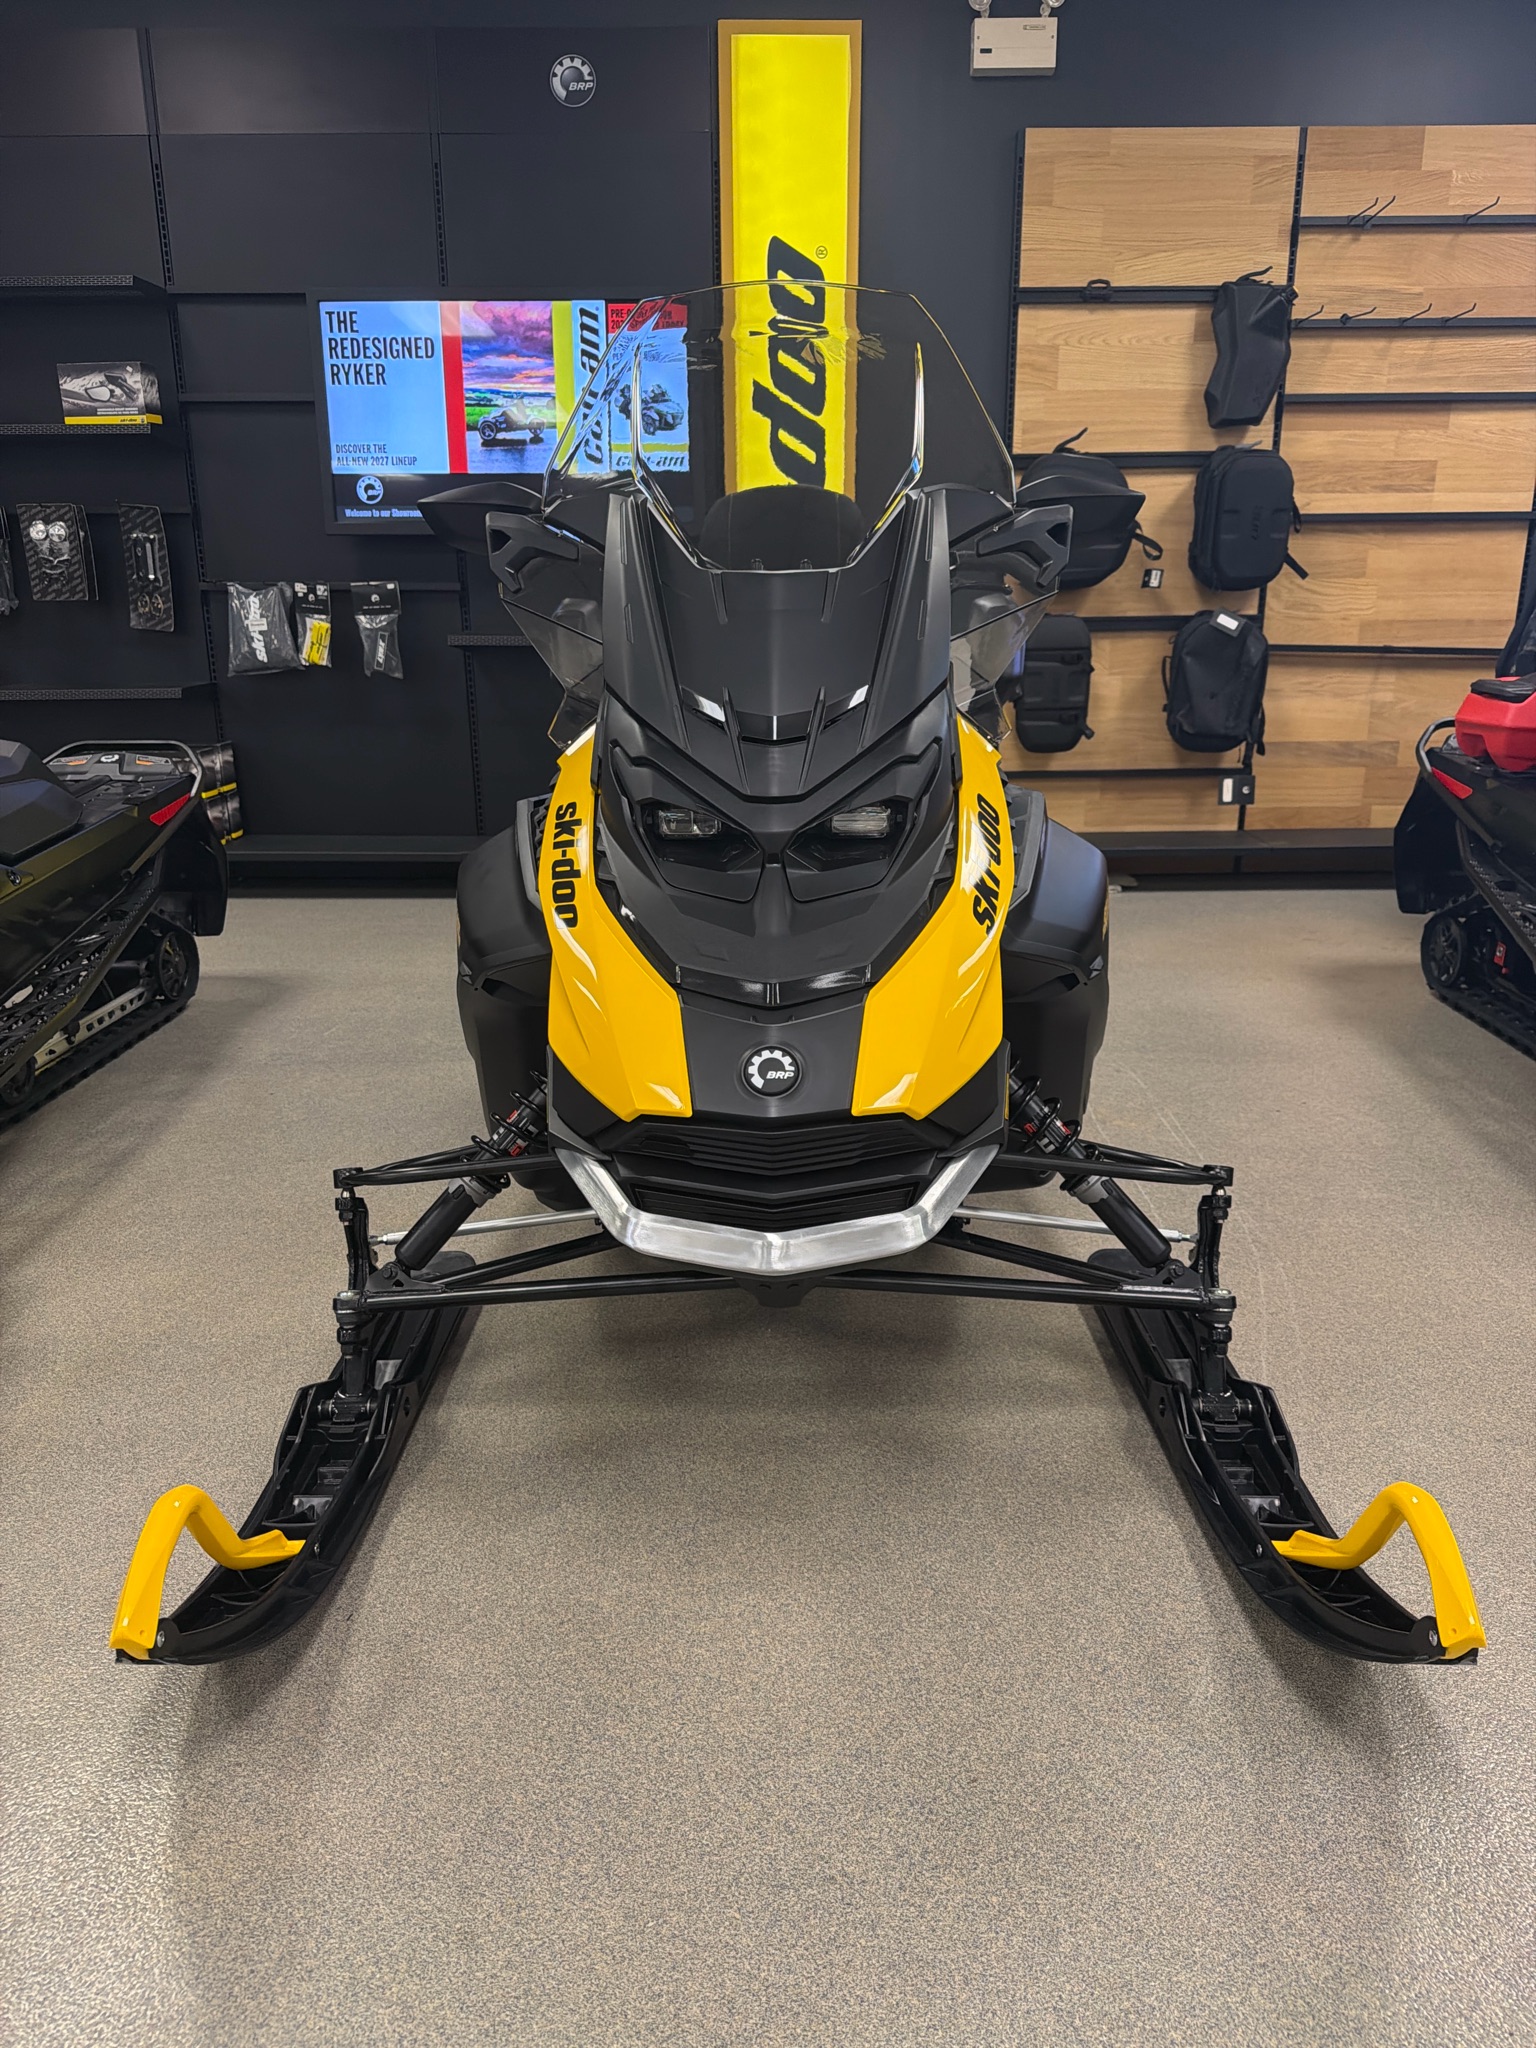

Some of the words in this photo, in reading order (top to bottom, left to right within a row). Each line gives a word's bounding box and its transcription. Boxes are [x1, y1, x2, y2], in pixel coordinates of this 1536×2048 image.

[568, 82, 594, 91] BRP
[324, 310, 360, 334] THE
[328, 336, 435, 360] REDESIGNED
[330, 363, 387, 386] RYKER
[335, 443, 372, 454] DISCOVER
[373, 443, 388, 454] THE
[336, 456, 369, 467] ALL-NEW
[370, 456, 389, 467] 2027
[391, 456, 418, 466] LINEUP
[615, 455, 685, 467] ca-am
[344, 508, 372, 518] Welcome
[372, 508, 380, 518] to
[380, 510, 391, 518] our
[552, 801, 583, 929] ski-doo
[766, 1070, 795, 1080] BRP
